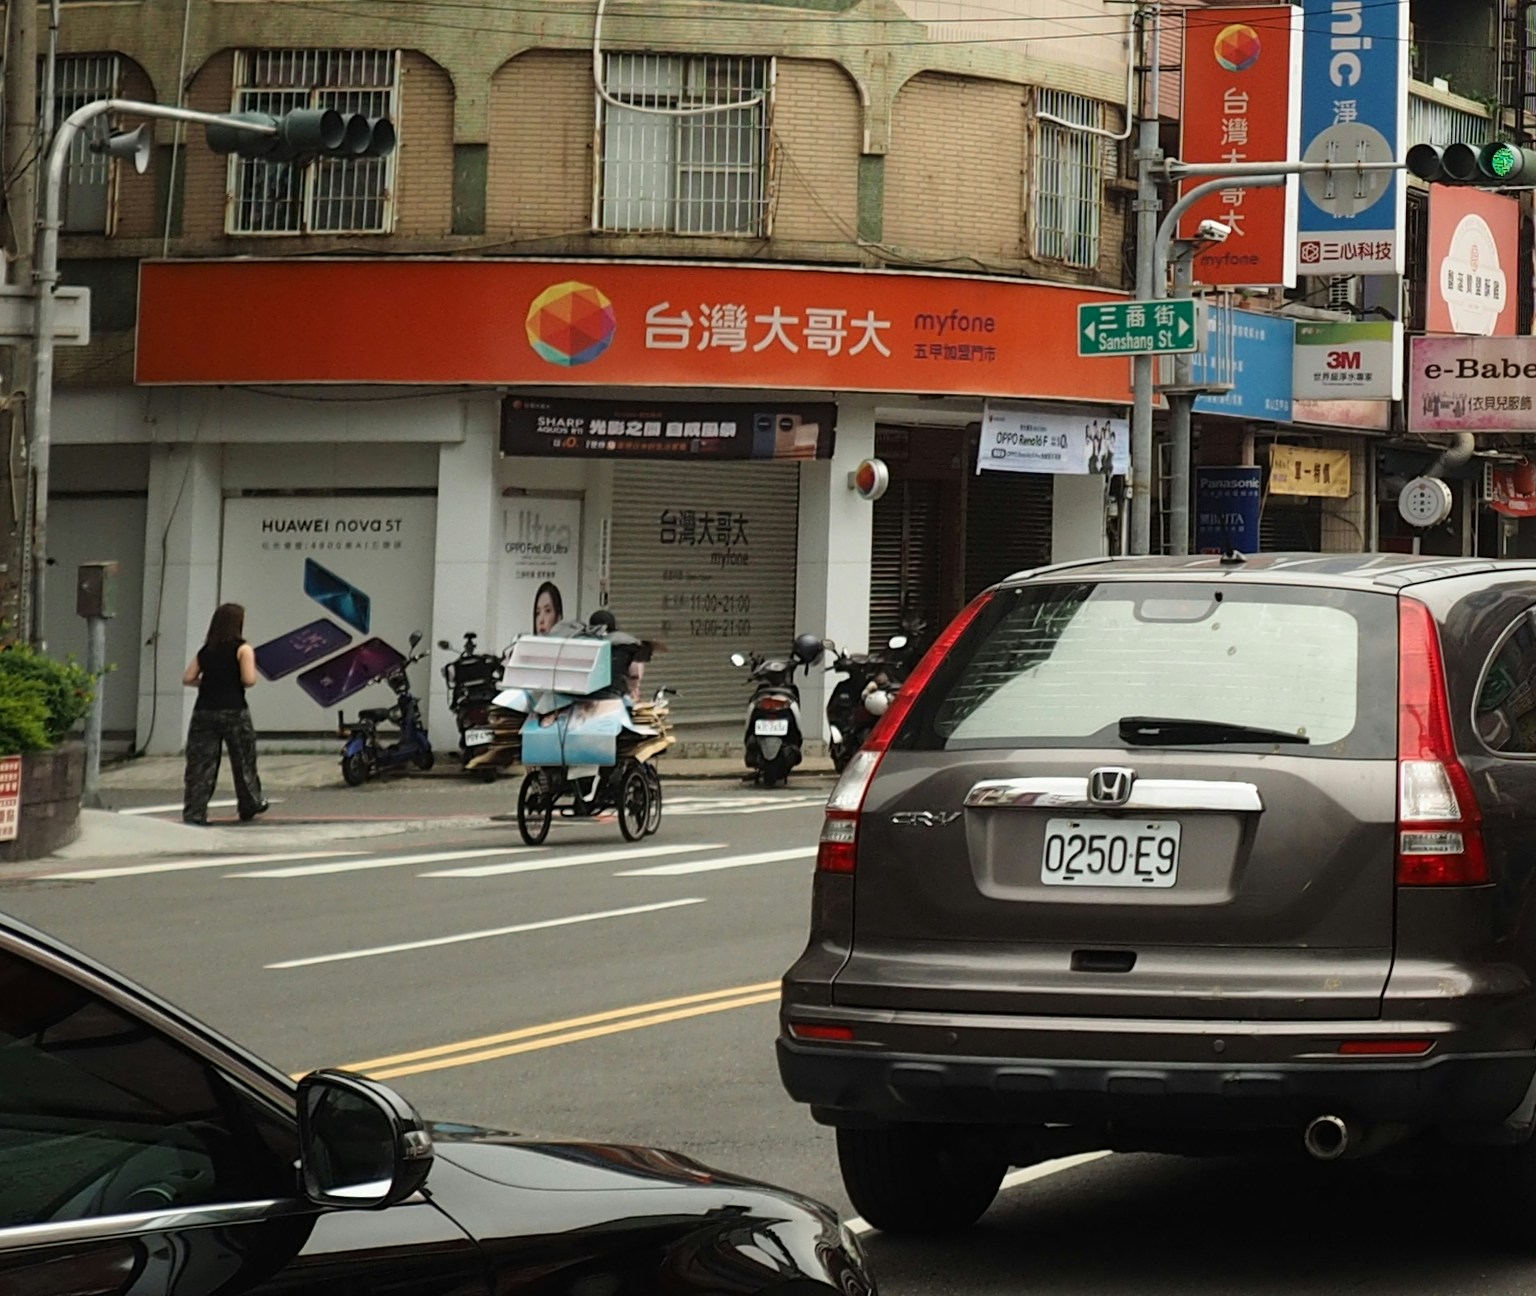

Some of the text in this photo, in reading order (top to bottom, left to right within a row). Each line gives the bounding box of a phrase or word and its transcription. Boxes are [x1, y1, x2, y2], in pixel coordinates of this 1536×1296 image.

[1322, 241, 1393, 262] 三心科技
[913, 308, 996, 338] myfone
[1097, 303, 1176, 331] 三商街
[644, 300, 892, 359] 台灣大哥大
[1097, 329, 1175, 353] Sanshang St.
[913, 342, 997, 363] 五甲加盟門市
[1326, 350, 1361, 370] 3M
[537, 416, 584, 428] SHARP
[1199, 477, 1260, 489] Panasonic
[261, 518, 403, 534] HUAWEI nova 5T
[658, 508, 750, 547] 台灣大哥大
[891, 810, 963, 827] CR-V
